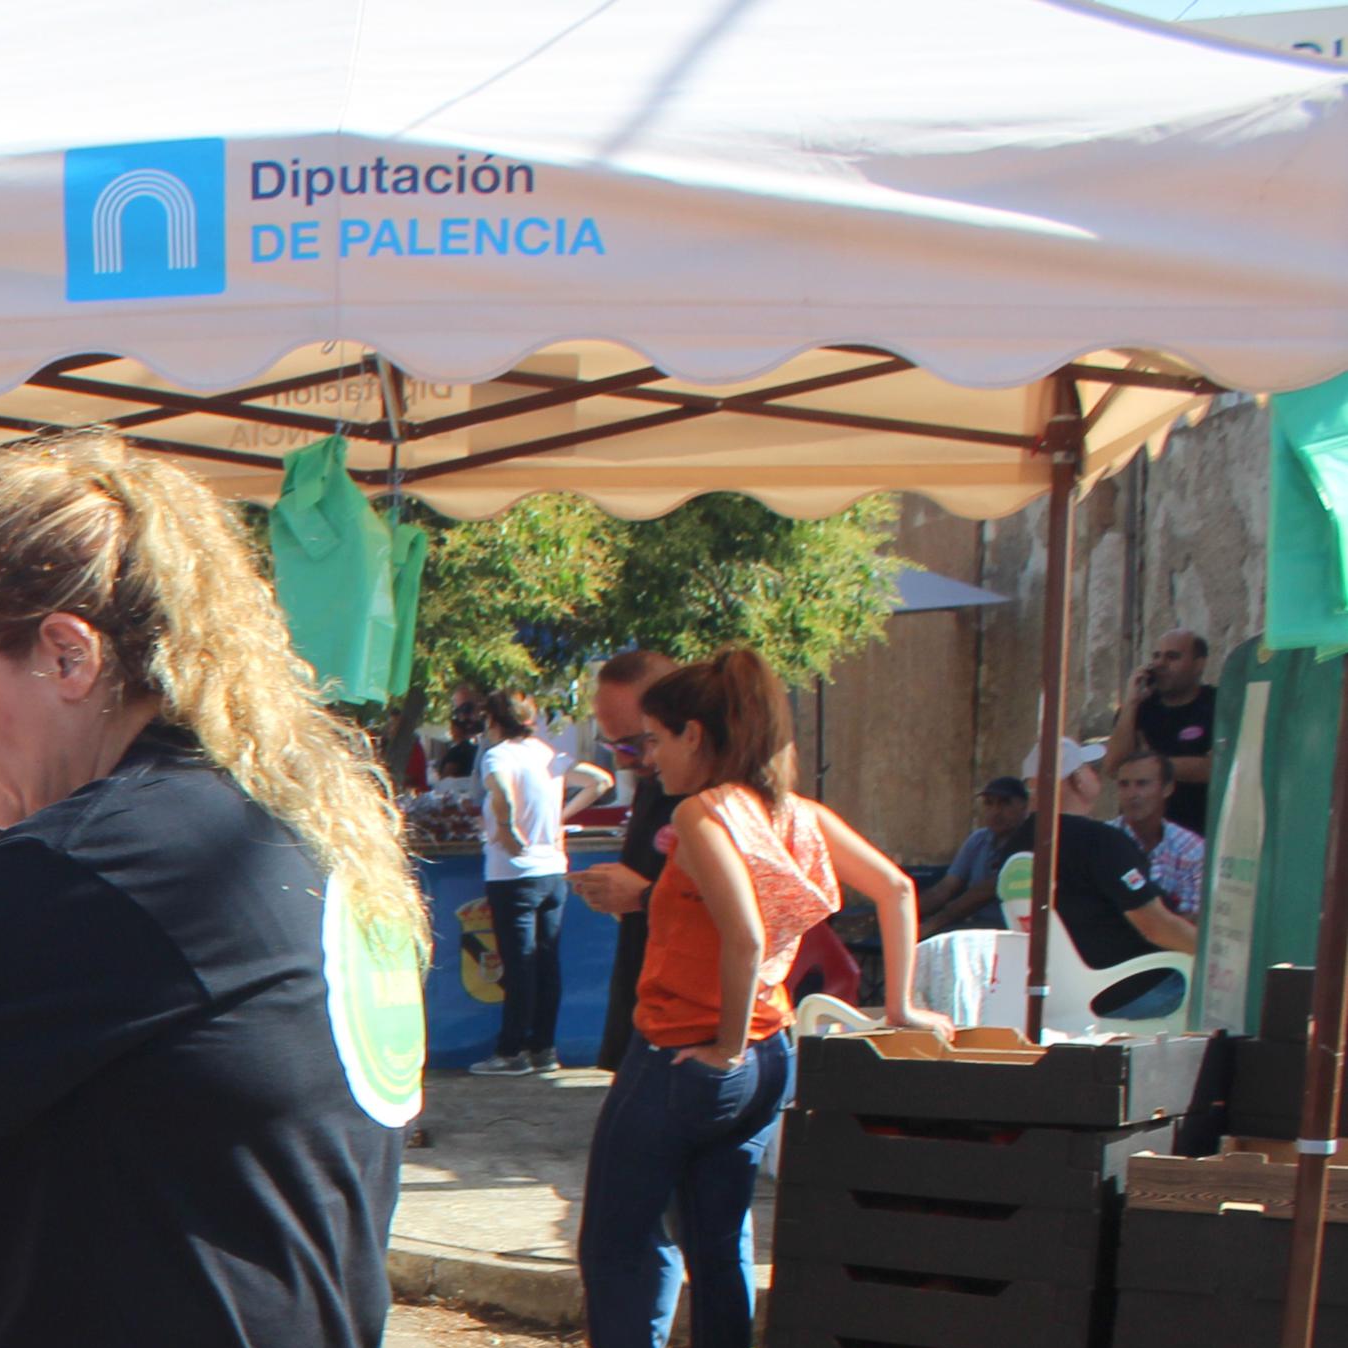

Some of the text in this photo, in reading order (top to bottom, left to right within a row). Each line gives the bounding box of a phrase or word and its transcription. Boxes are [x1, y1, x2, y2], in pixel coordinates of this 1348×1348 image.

[250, 154, 535, 207] Diputación
[250, 217, 607, 264] DE PALENCIA
